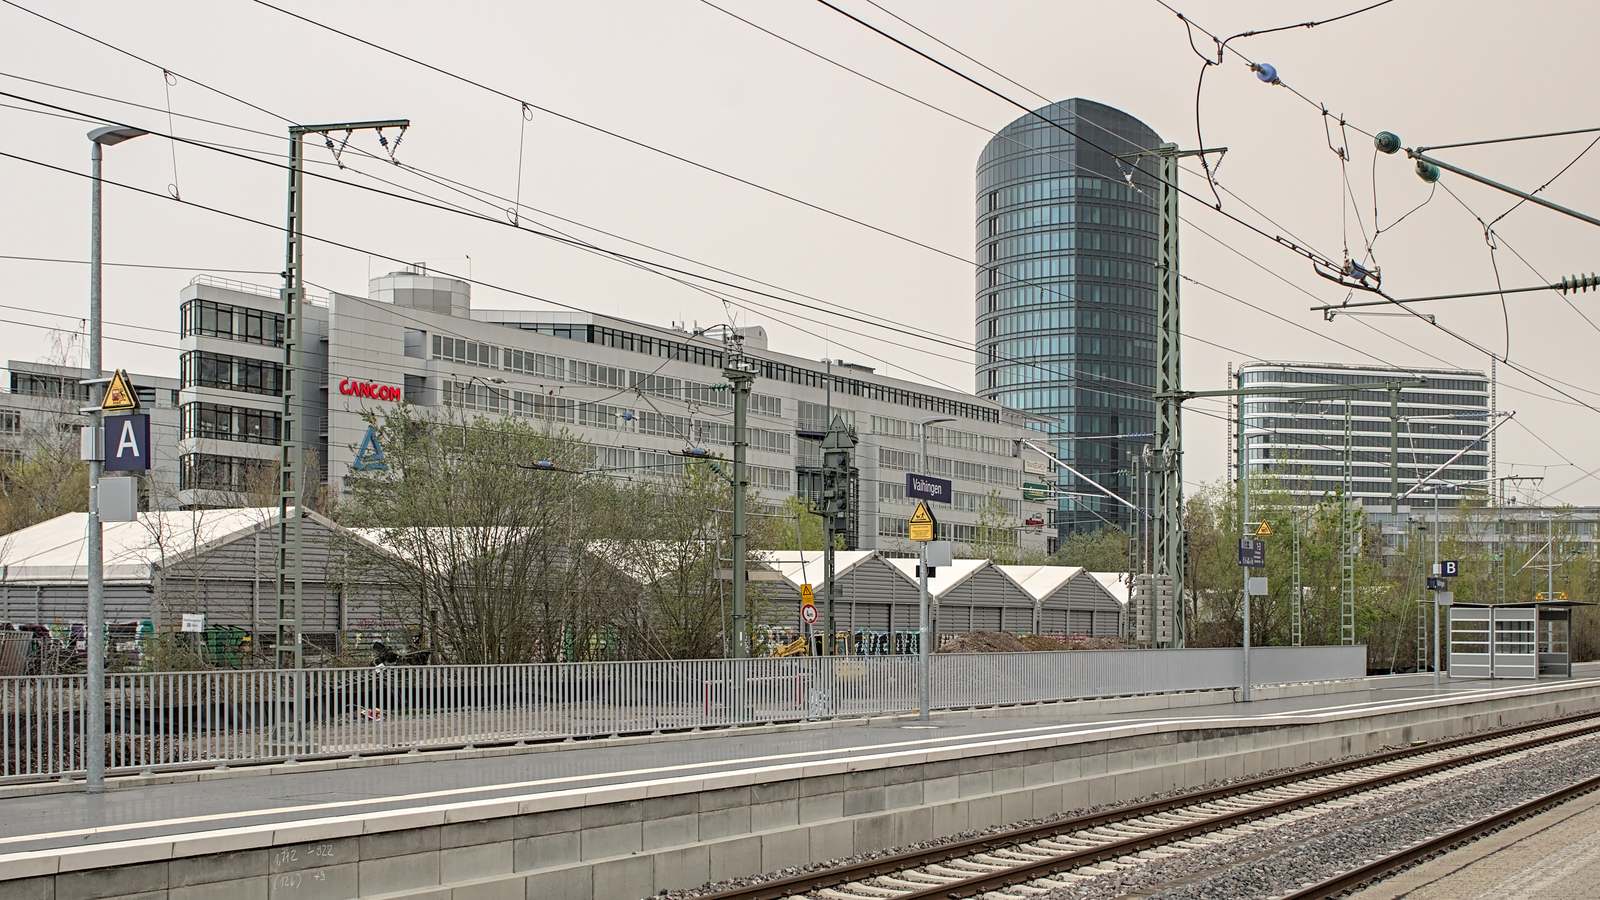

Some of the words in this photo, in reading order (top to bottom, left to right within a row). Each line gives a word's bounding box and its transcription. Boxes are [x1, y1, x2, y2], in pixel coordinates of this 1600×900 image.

[339, 379, 401, 401] CANCOM
[116, 420, 140, 458] A
[912, 477, 943, 496] Vaihingen
[1447, 562, 1456, 574] B
